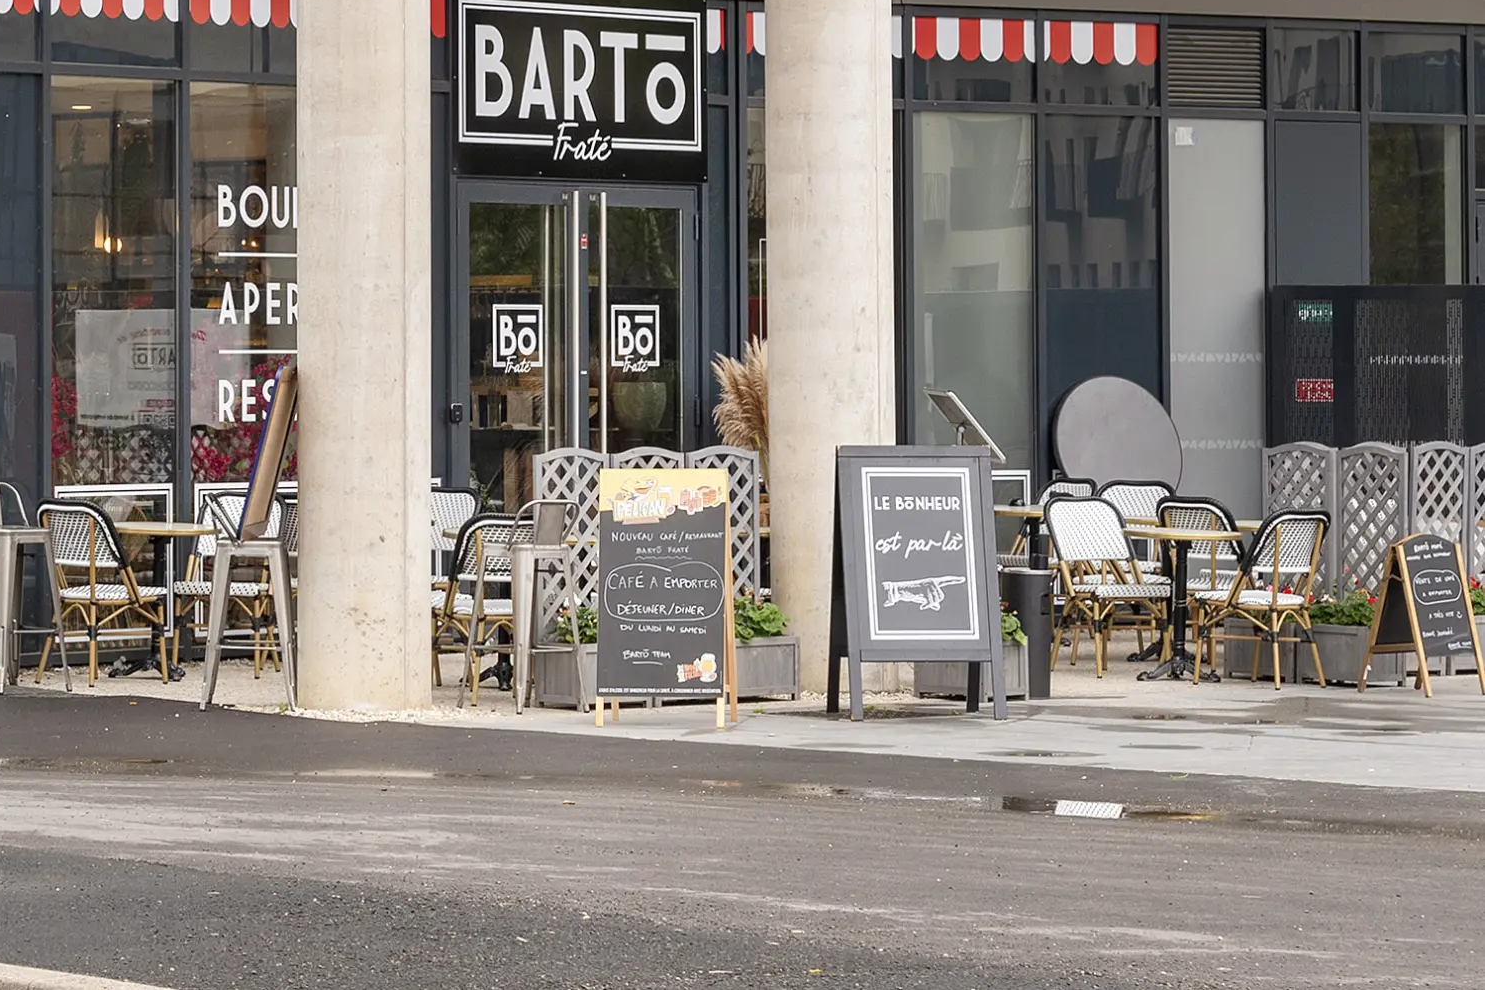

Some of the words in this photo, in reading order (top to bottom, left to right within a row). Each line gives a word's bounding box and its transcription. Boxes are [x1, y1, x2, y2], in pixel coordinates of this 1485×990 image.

[553, 122, 612, 161] Fraté
[874, 496, 891, 510] LE
[611, 531, 654, 543] NOUVEAU
[875, 531, 902, 554] est
[608, 570, 644, 590] CAFÉ
[649, 576, 658, 589] A
[664, 576, 718, 589] EMPORTER
